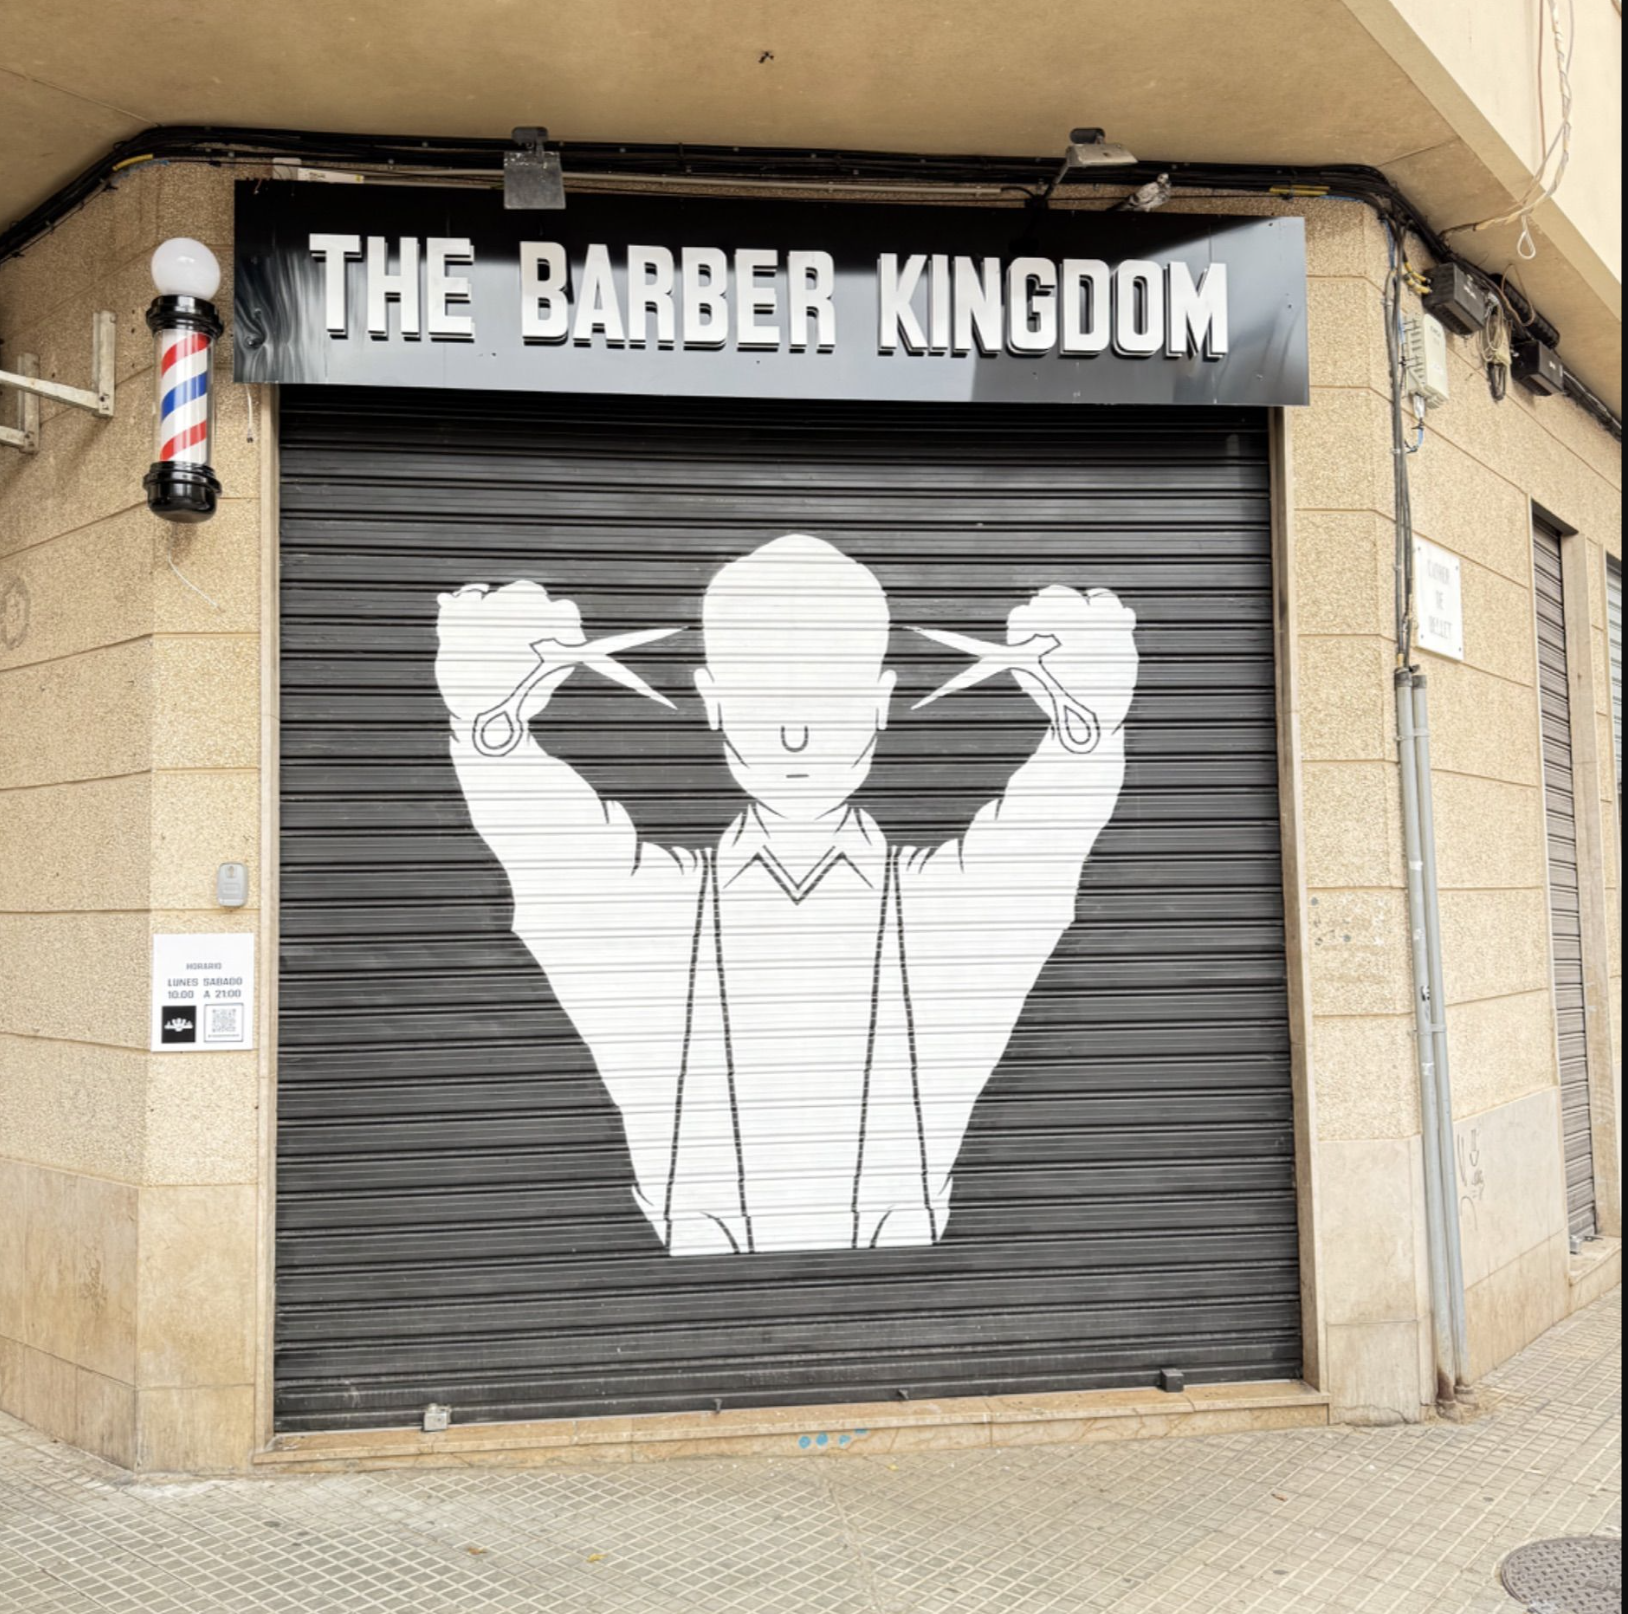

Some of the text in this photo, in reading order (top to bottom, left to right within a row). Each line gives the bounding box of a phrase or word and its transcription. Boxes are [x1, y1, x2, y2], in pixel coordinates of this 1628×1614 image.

[308, 233, 1230, 360] THE BARBER KINGDOM
[186, 962, 222, 970] HORARIO
[167, 977, 243, 987] LUNES SABADO
[203, 990, 211, 998] A
